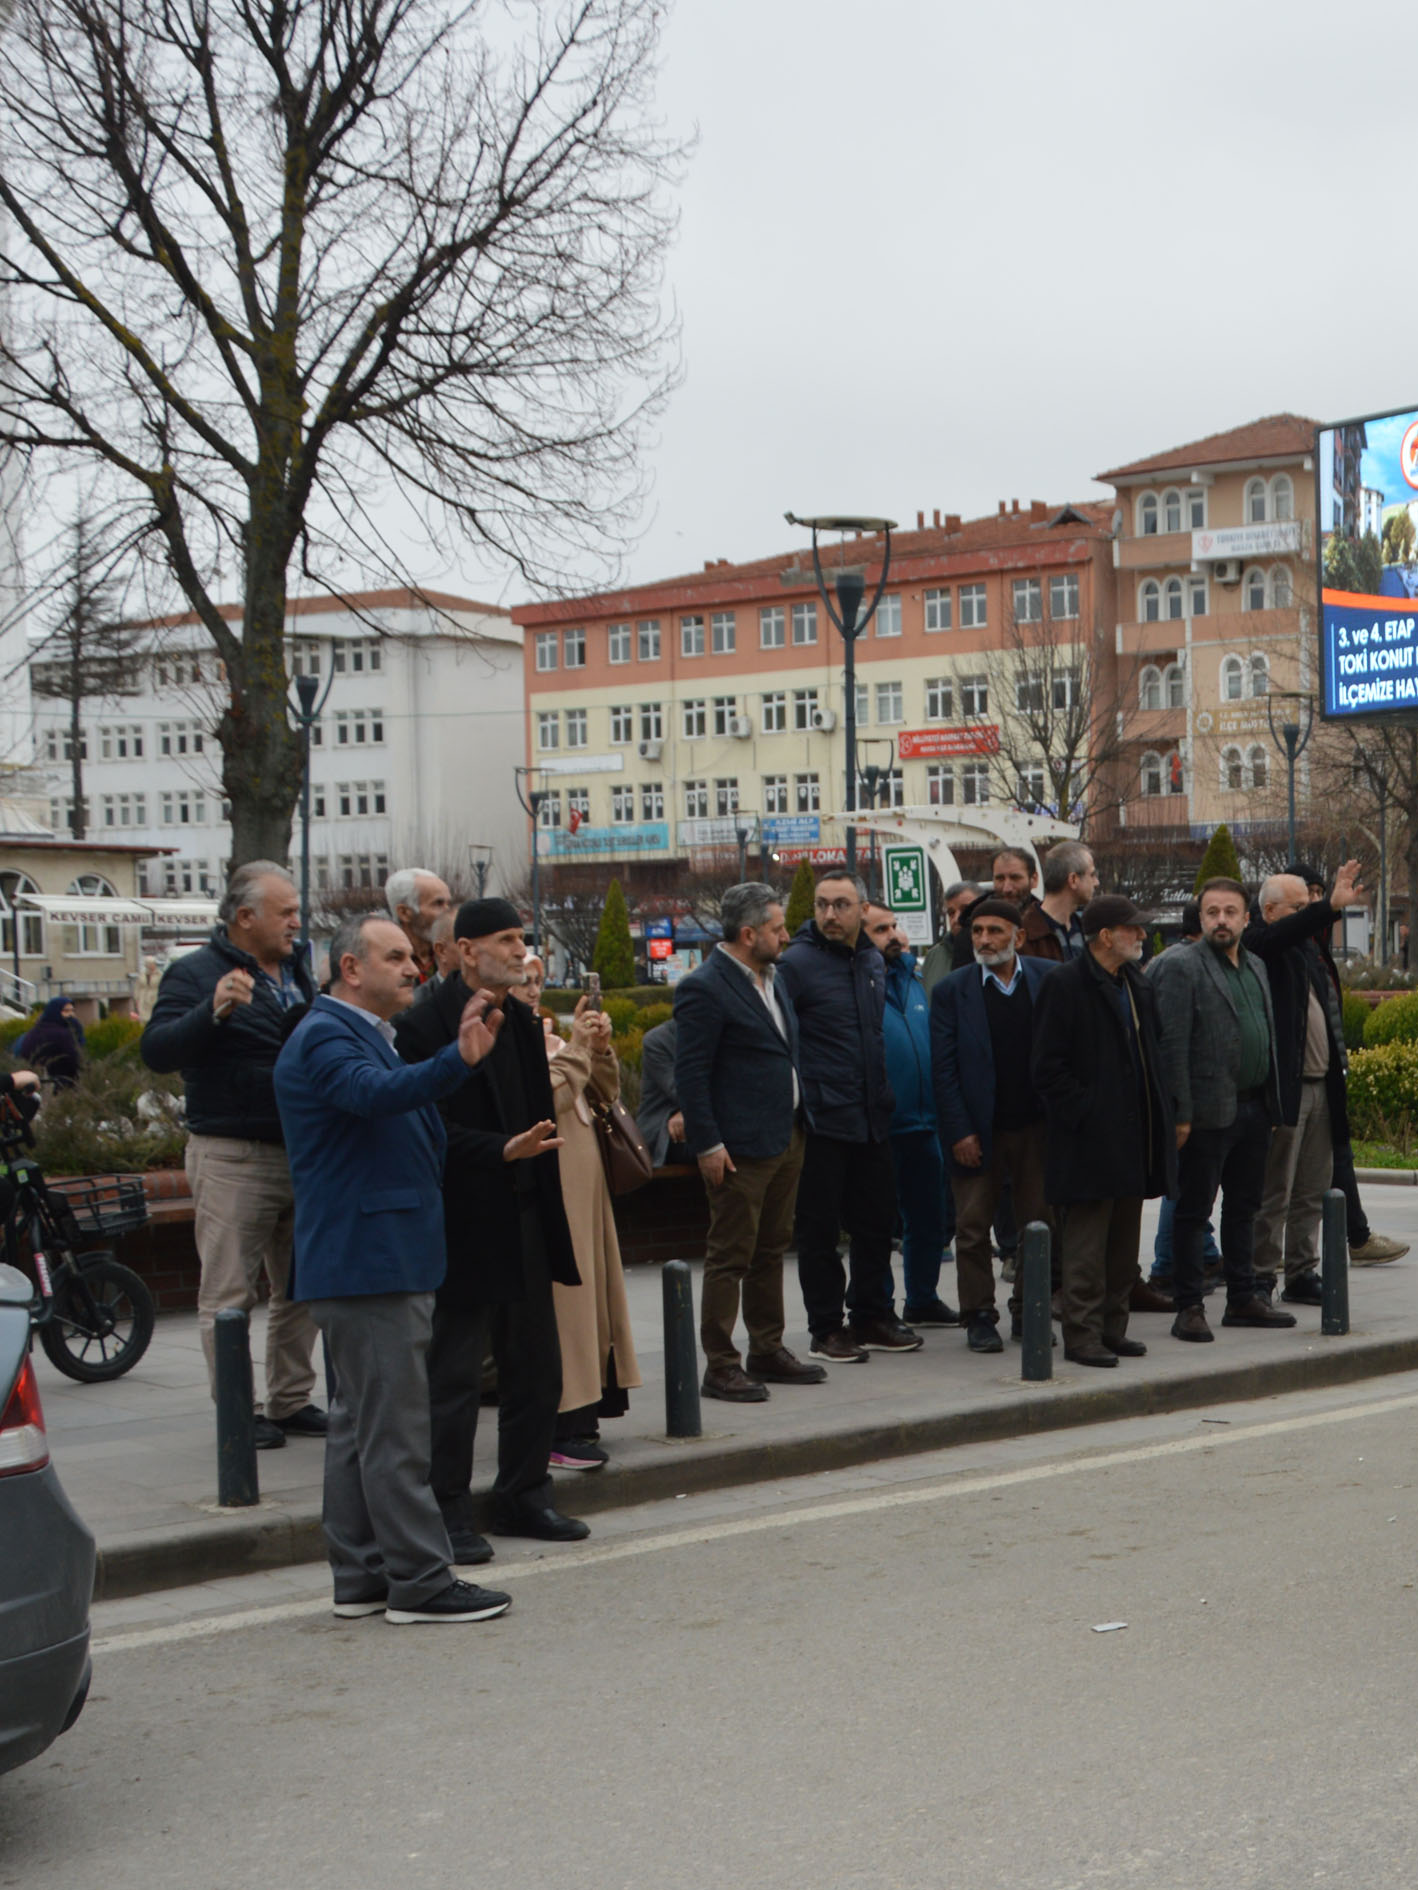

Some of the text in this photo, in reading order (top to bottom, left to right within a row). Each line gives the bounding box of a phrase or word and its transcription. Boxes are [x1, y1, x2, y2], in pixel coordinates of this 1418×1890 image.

[1339, 618, 1415, 648] 3. ve 4. ETAP
[1339, 648, 1367, 675] TOKİ
[1370, 647, 1414, 672] KONUT
[1339, 677, 1394, 708] İLÇEMİZE
[50, 912, 107, 923] KEVSER
[157, 914, 208, 925] KEVSER
